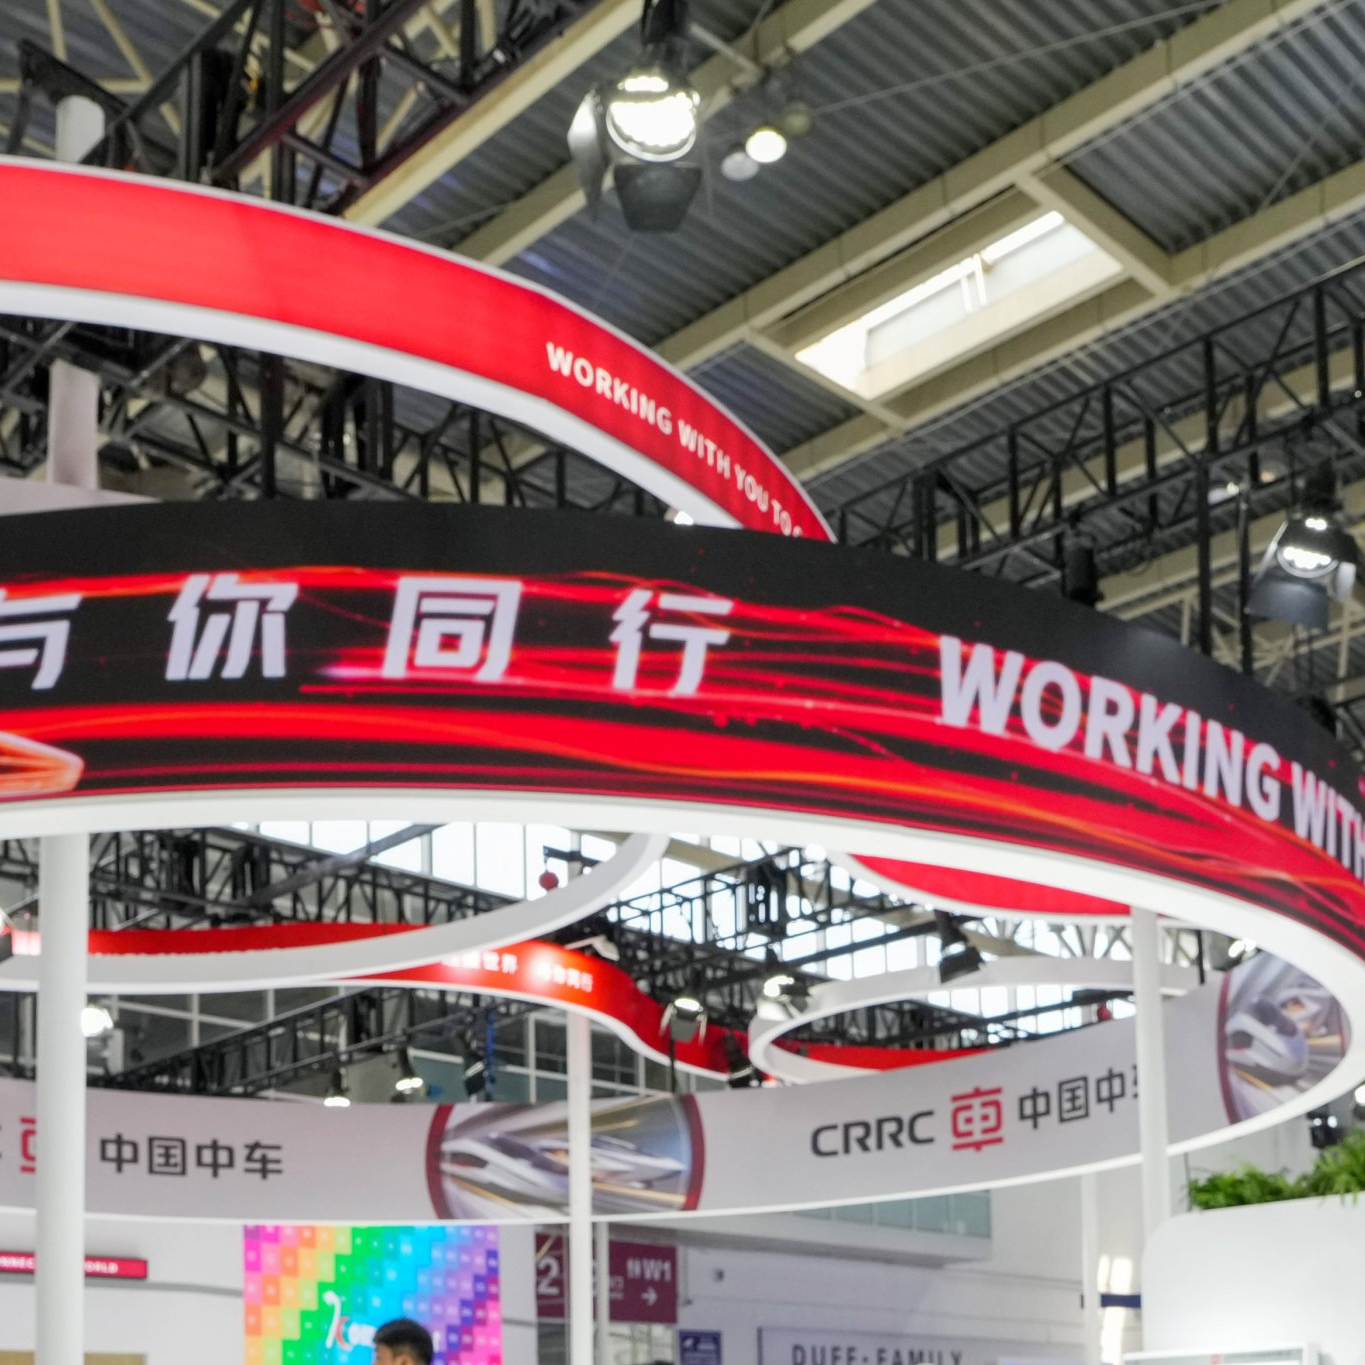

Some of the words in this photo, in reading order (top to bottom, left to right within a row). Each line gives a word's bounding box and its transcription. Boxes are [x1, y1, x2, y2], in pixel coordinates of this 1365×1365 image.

[546, 341, 672, 436] WORKING
[678, 418, 732, 480] WITH
[734, 463, 769, 513] YOU
[771, 499, 792, 537] TO
[938, 635, 1281, 822] WORKING
[1018, 1064, 1139, 1131] 中国中
[100, 1133, 284, 1180] 中国中车
[811, 1110, 935, 1158] CRRC
[85, 1261, 118, 1274] ORLD
